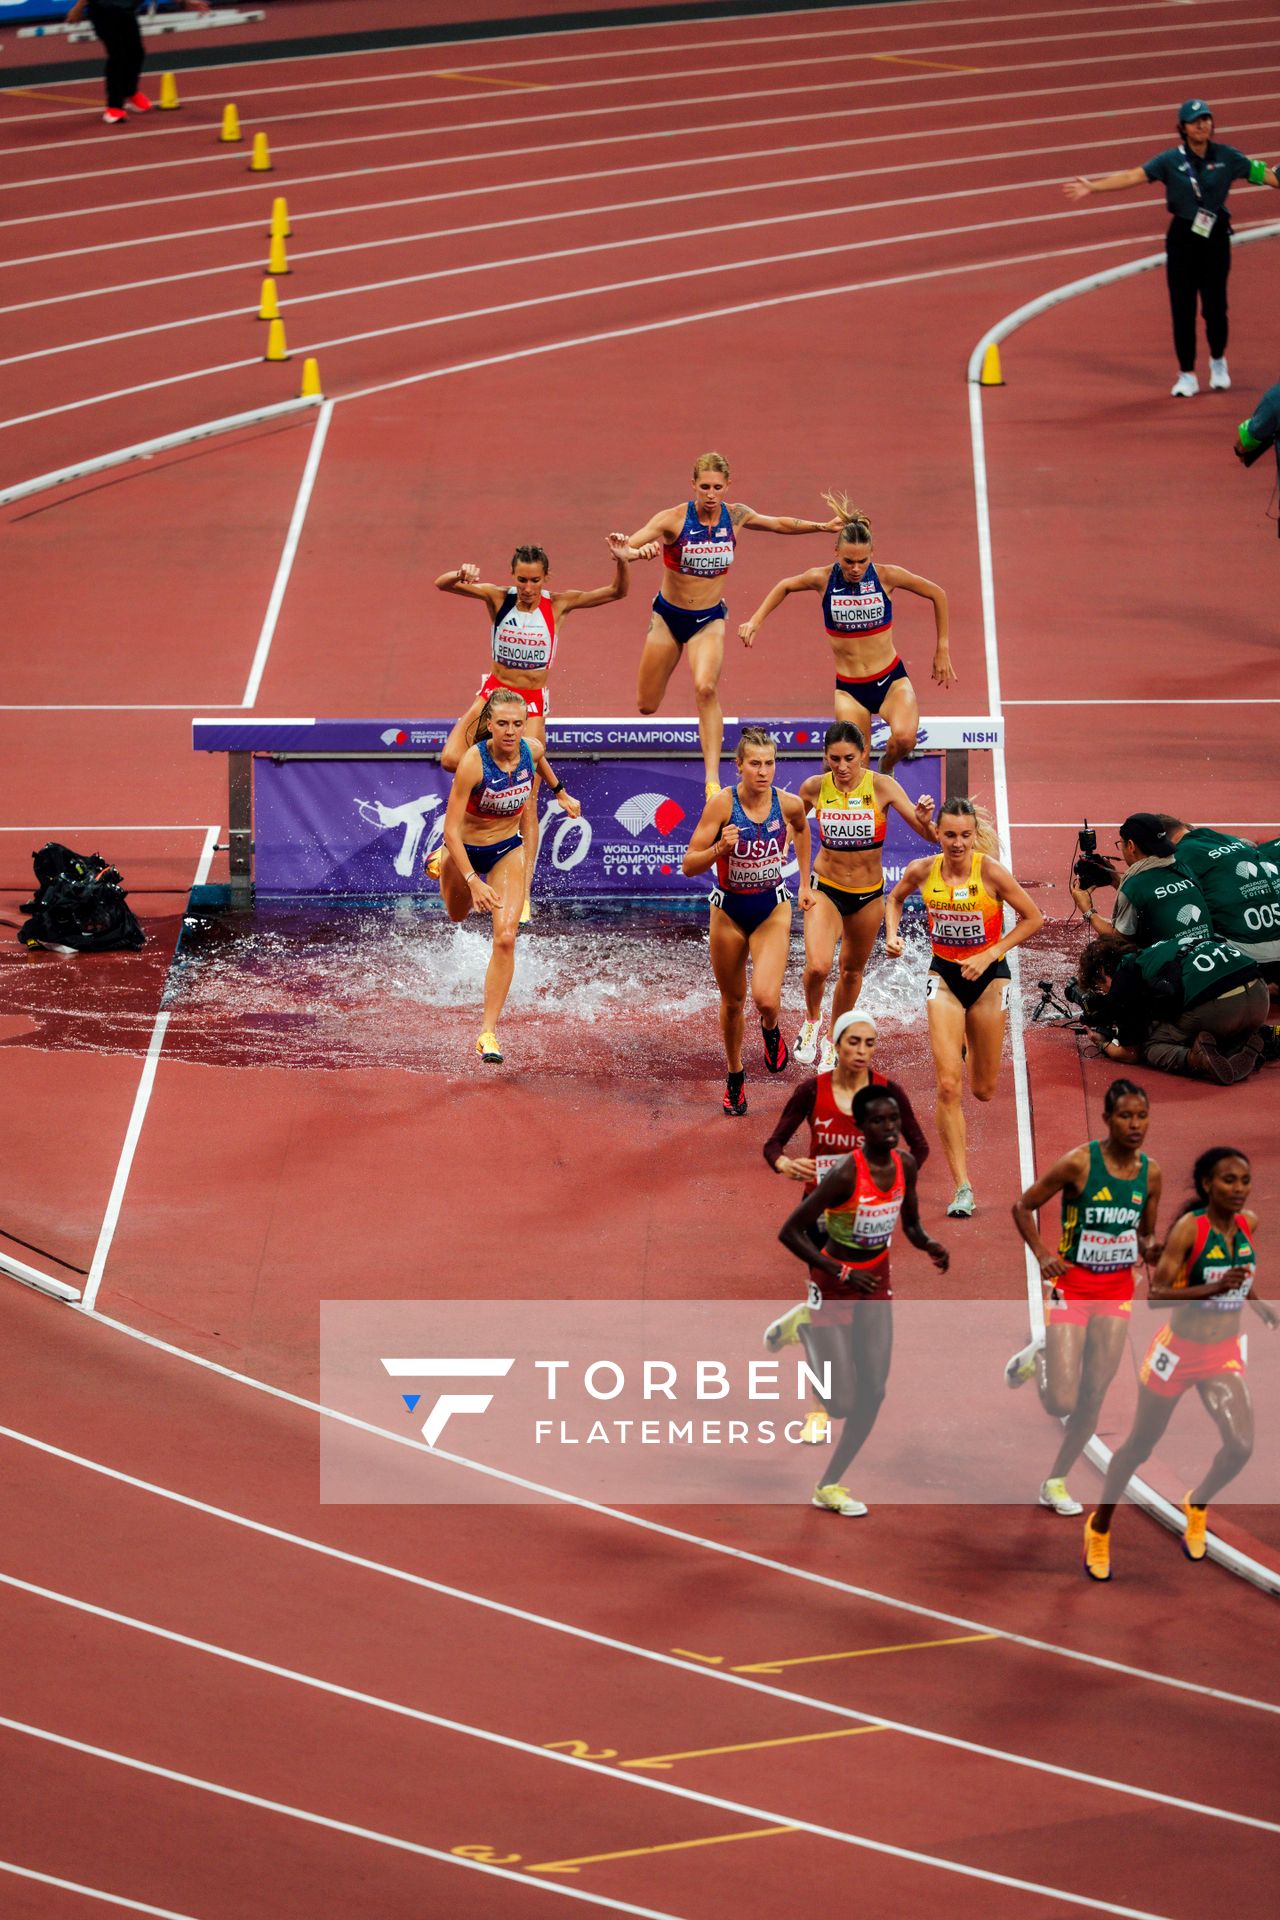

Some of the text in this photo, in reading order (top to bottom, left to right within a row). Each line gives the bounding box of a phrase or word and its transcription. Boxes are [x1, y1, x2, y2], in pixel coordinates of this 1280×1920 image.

[684, 545, 731, 554] HONDA
[684, 557, 730, 568] MITCHELL
[832, 596, 882, 607] HONDA
[834, 607, 882, 621] THORNER
[499, 634, 547, 647] HONDA
[499, 645, 546, 661] RENOUARD
[545, 731, 603, 743] HLETICS
[962, 732, 998, 743] NISHI
[484, 785, 530, 800] HONDA
[822, 812, 873, 821] HONDA
[823, 825, 872, 838] KRAUSE
[603, 844, 690, 854] WORLD ATHLETIC
[734, 838, 780, 858] USA
[1208, 842, 1246, 860] SONY
[730, 856, 781, 869] HONDA
[730, 867, 780, 881] NAPOLEON
[1154, 879, 1195, 900] SONY
[929, 900, 977, 912] GERMANY
[930, 911, 981, 921] HONDA
[1243, 902, 1280, 930] 005
[935, 921, 982, 937] MEYER
[816, 1132, 865, 1148] TUNIS
[1082, 1233, 1136, 1246] HONDA
[1081, 1248, 1134, 1262] MULETA
[1155, 1353, 1169, 1372] 8
